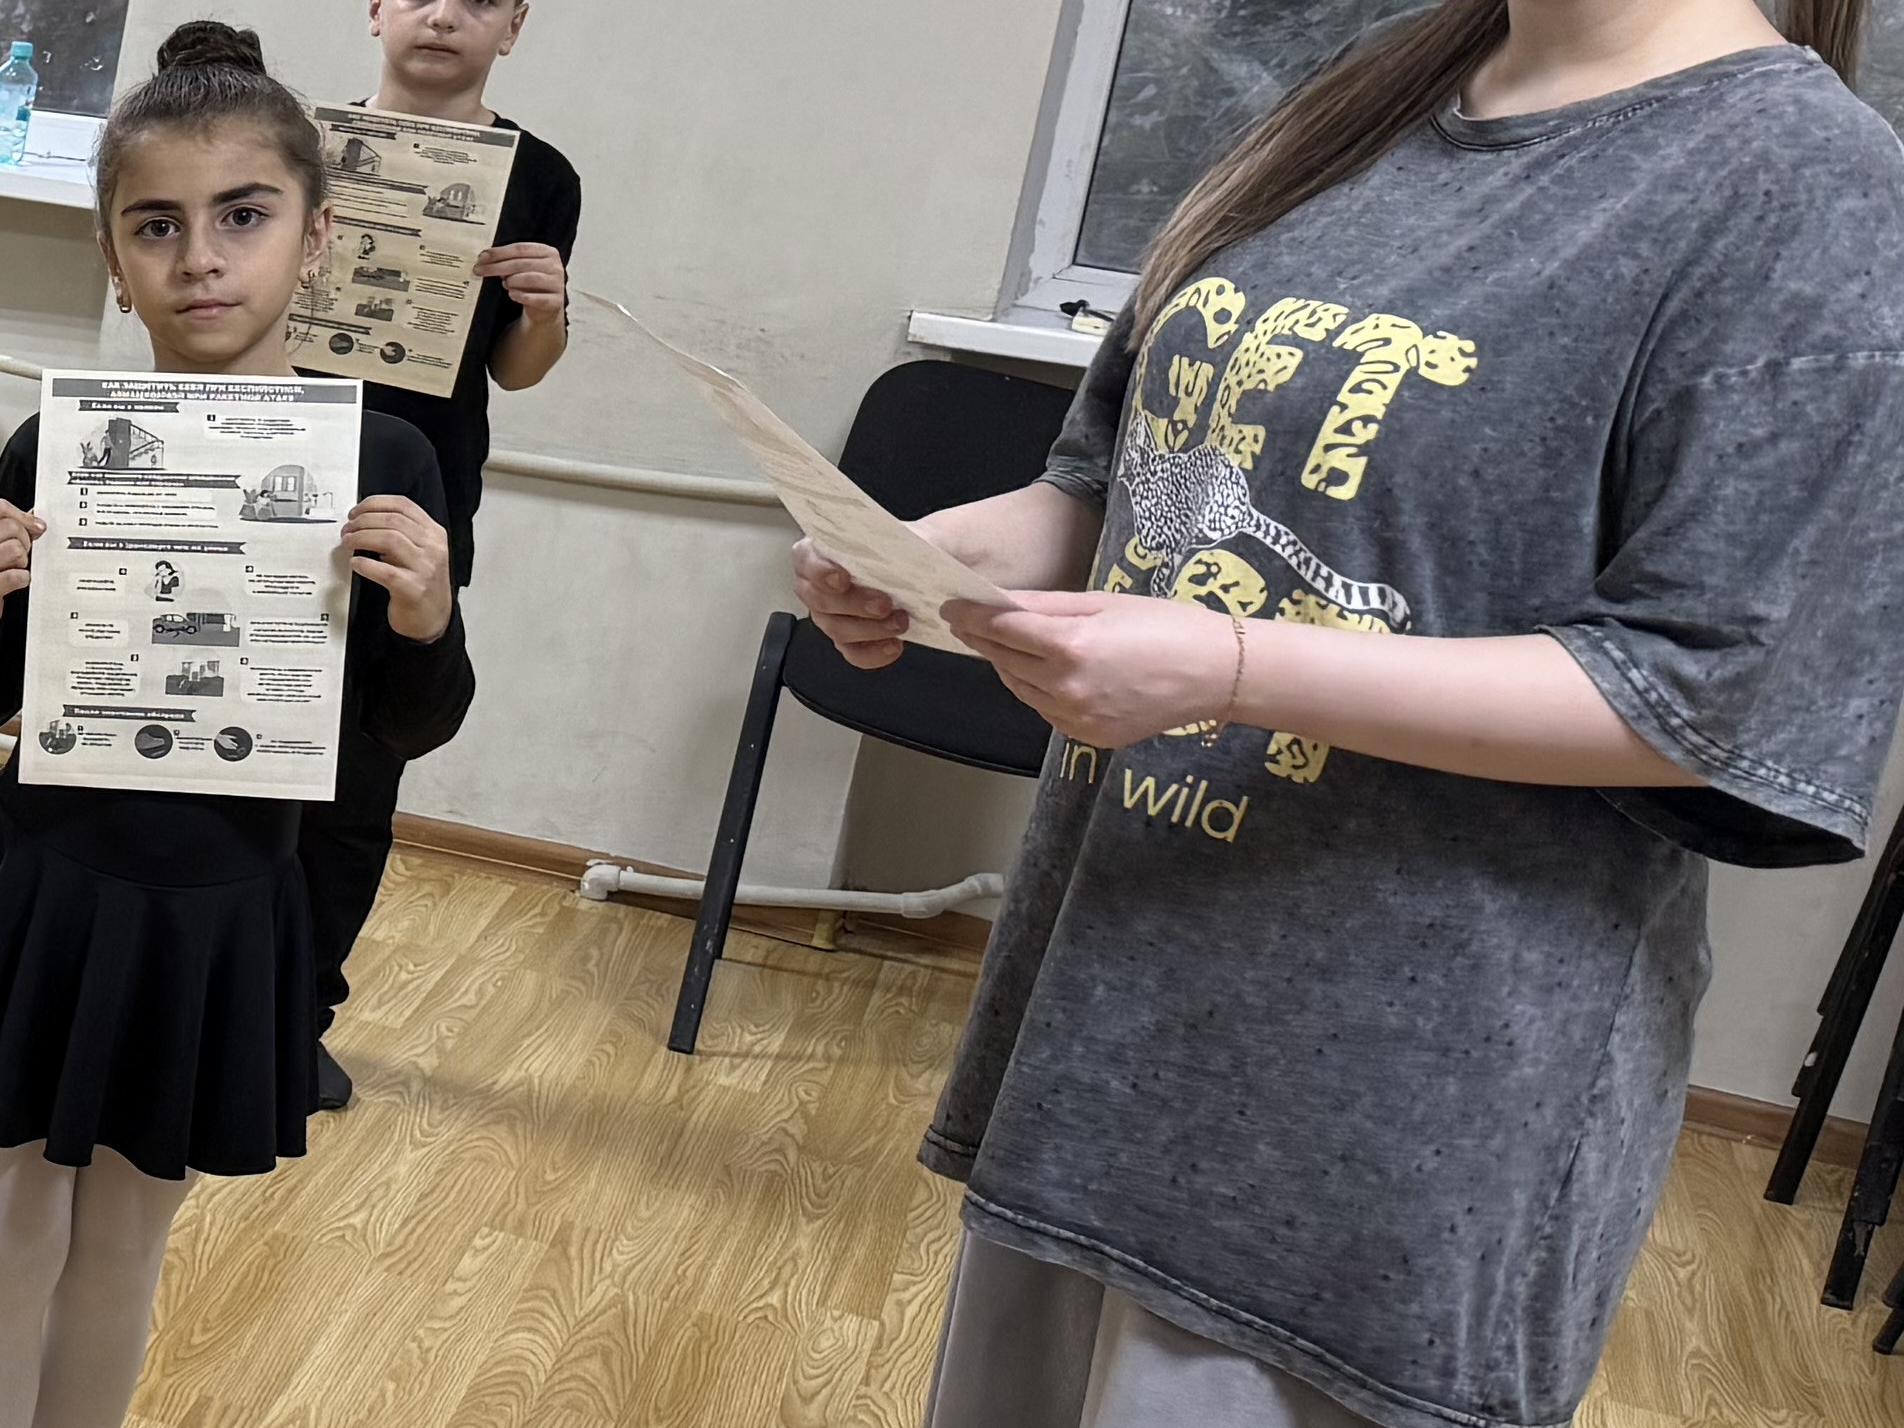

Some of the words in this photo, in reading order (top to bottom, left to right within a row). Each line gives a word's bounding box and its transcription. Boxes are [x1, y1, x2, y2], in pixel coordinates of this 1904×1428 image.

[1130, 276, 1478, 500] GET
[1060, 739, 1096, 784] in
[1124, 769, 1248, 843] wild
